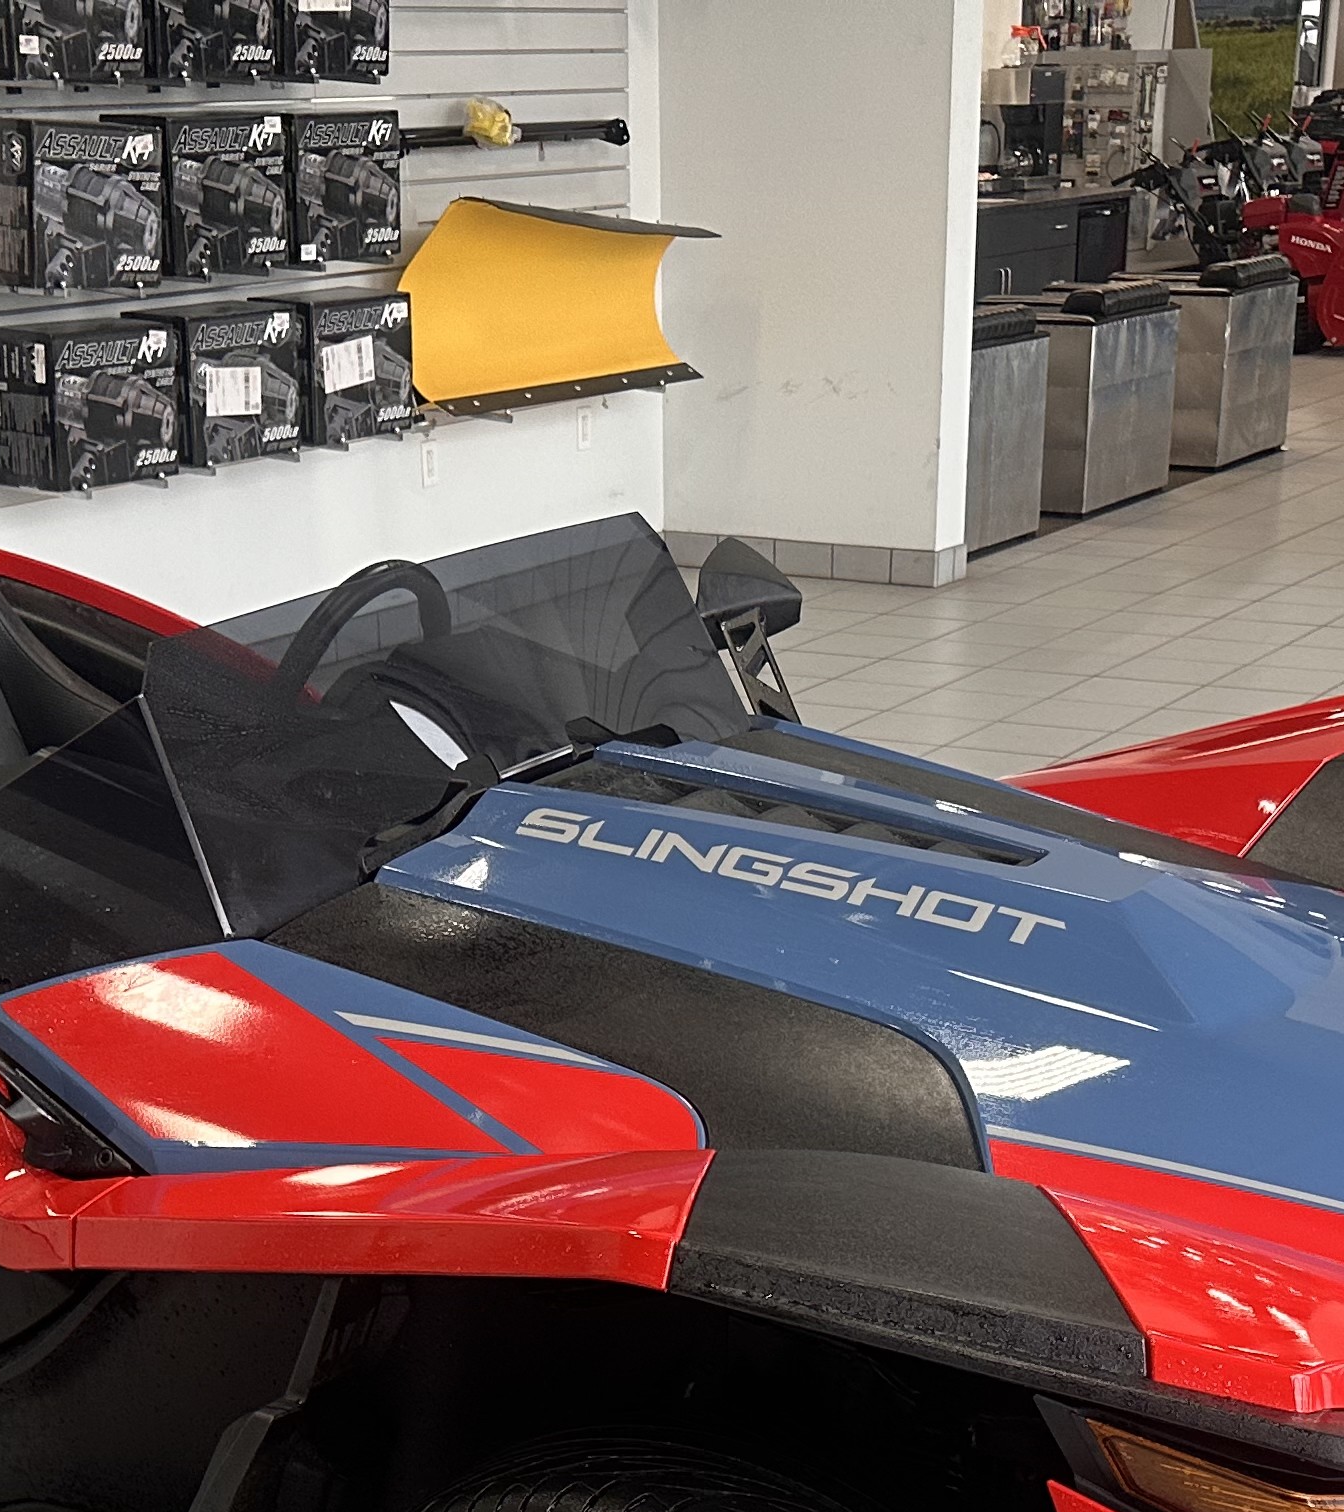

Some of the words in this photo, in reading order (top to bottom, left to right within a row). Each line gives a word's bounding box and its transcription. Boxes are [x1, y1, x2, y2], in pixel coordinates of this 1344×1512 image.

[35, 128, 125, 161] ASSAULT
[172, 125, 250, 153] ASSAULT
[298, 121, 368, 148] ASSAULT
[1290, 234, 1332, 254] HONDA
[56, 339, 139, 370] ASSAULT
[515, 806, 1067, 946] SLINGSHOT
